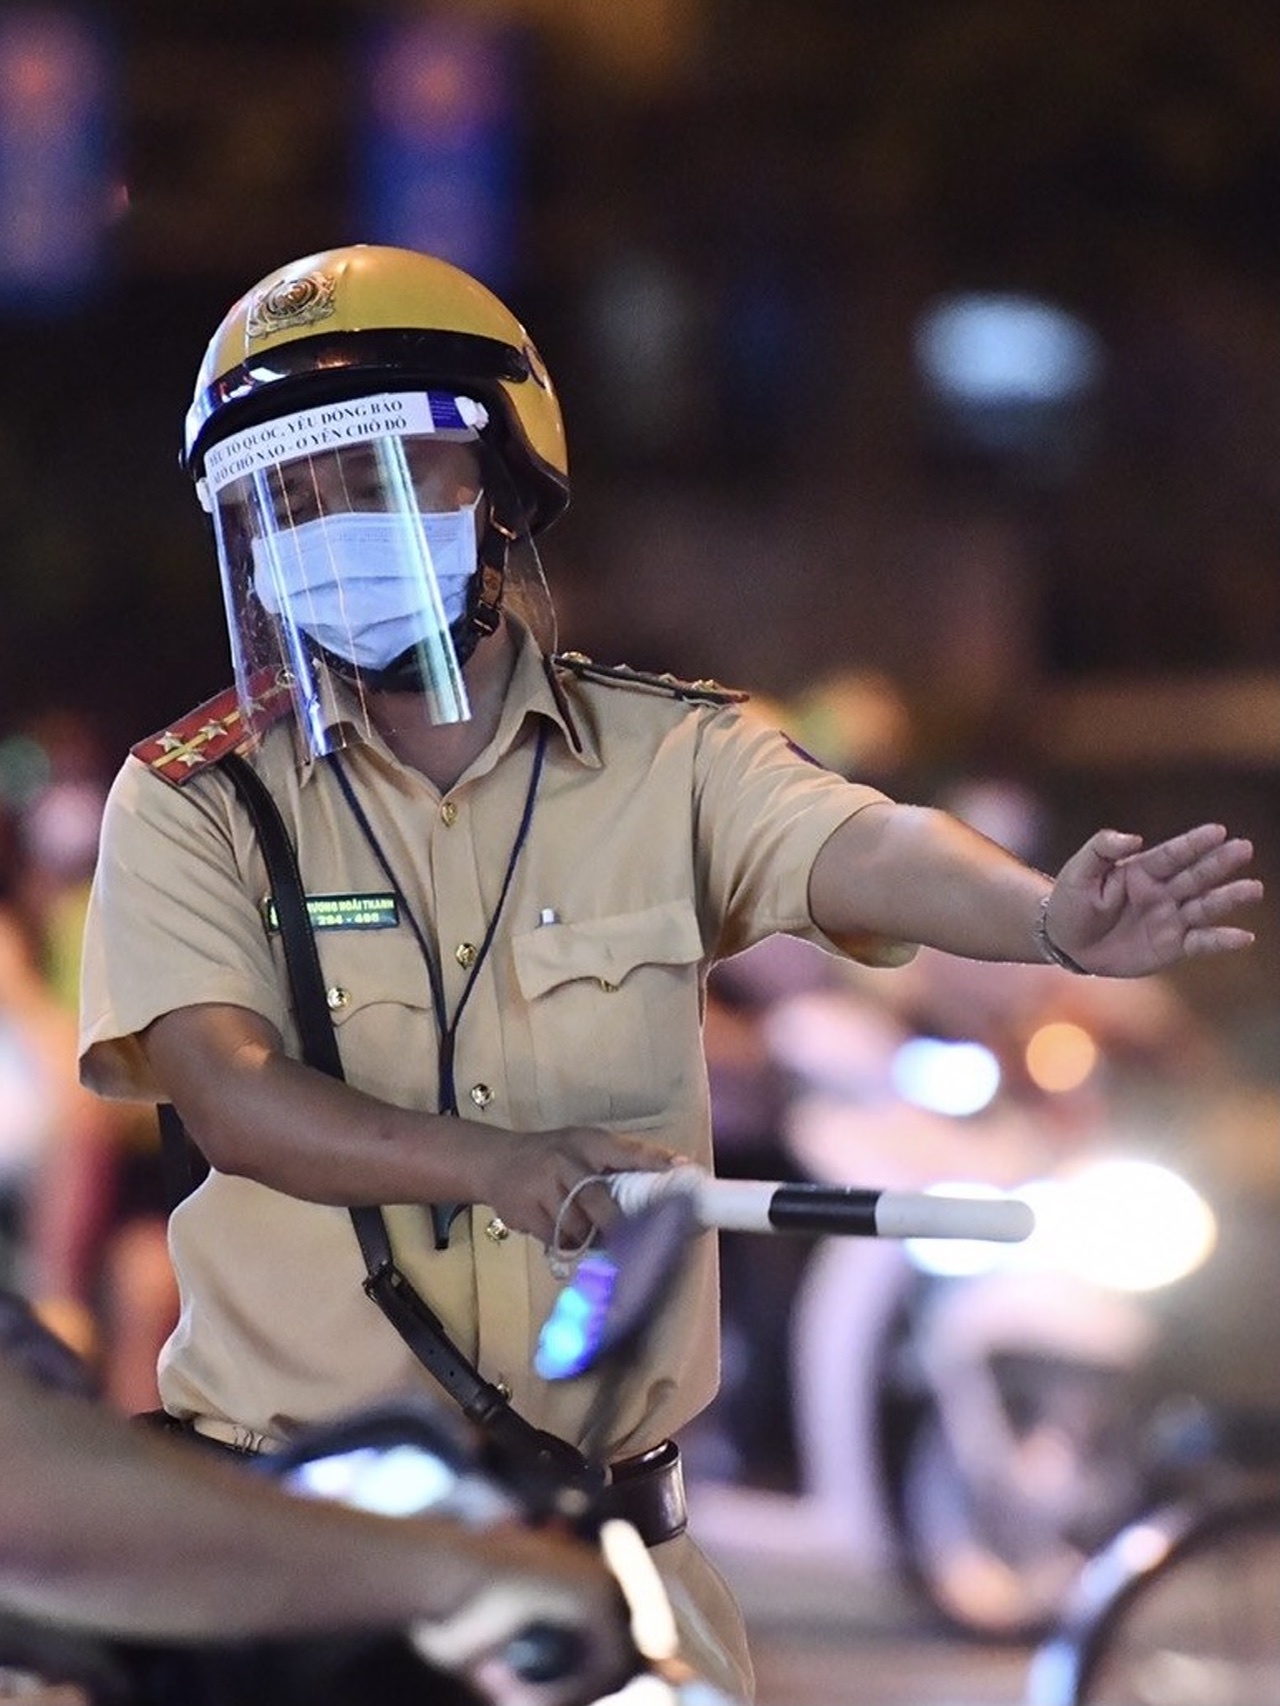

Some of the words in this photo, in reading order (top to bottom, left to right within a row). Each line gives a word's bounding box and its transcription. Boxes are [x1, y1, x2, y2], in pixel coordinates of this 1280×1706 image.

[288, 414, 316, 433] YÊU
[321, 404, 367, 424] ĐỒNG
[371, 397, 403, 414] BÀO
[256, 443, 285, 460] NÀO
[311, 427, 342, 445] YÊN
[346, 418, 381, 437] CHỖ
